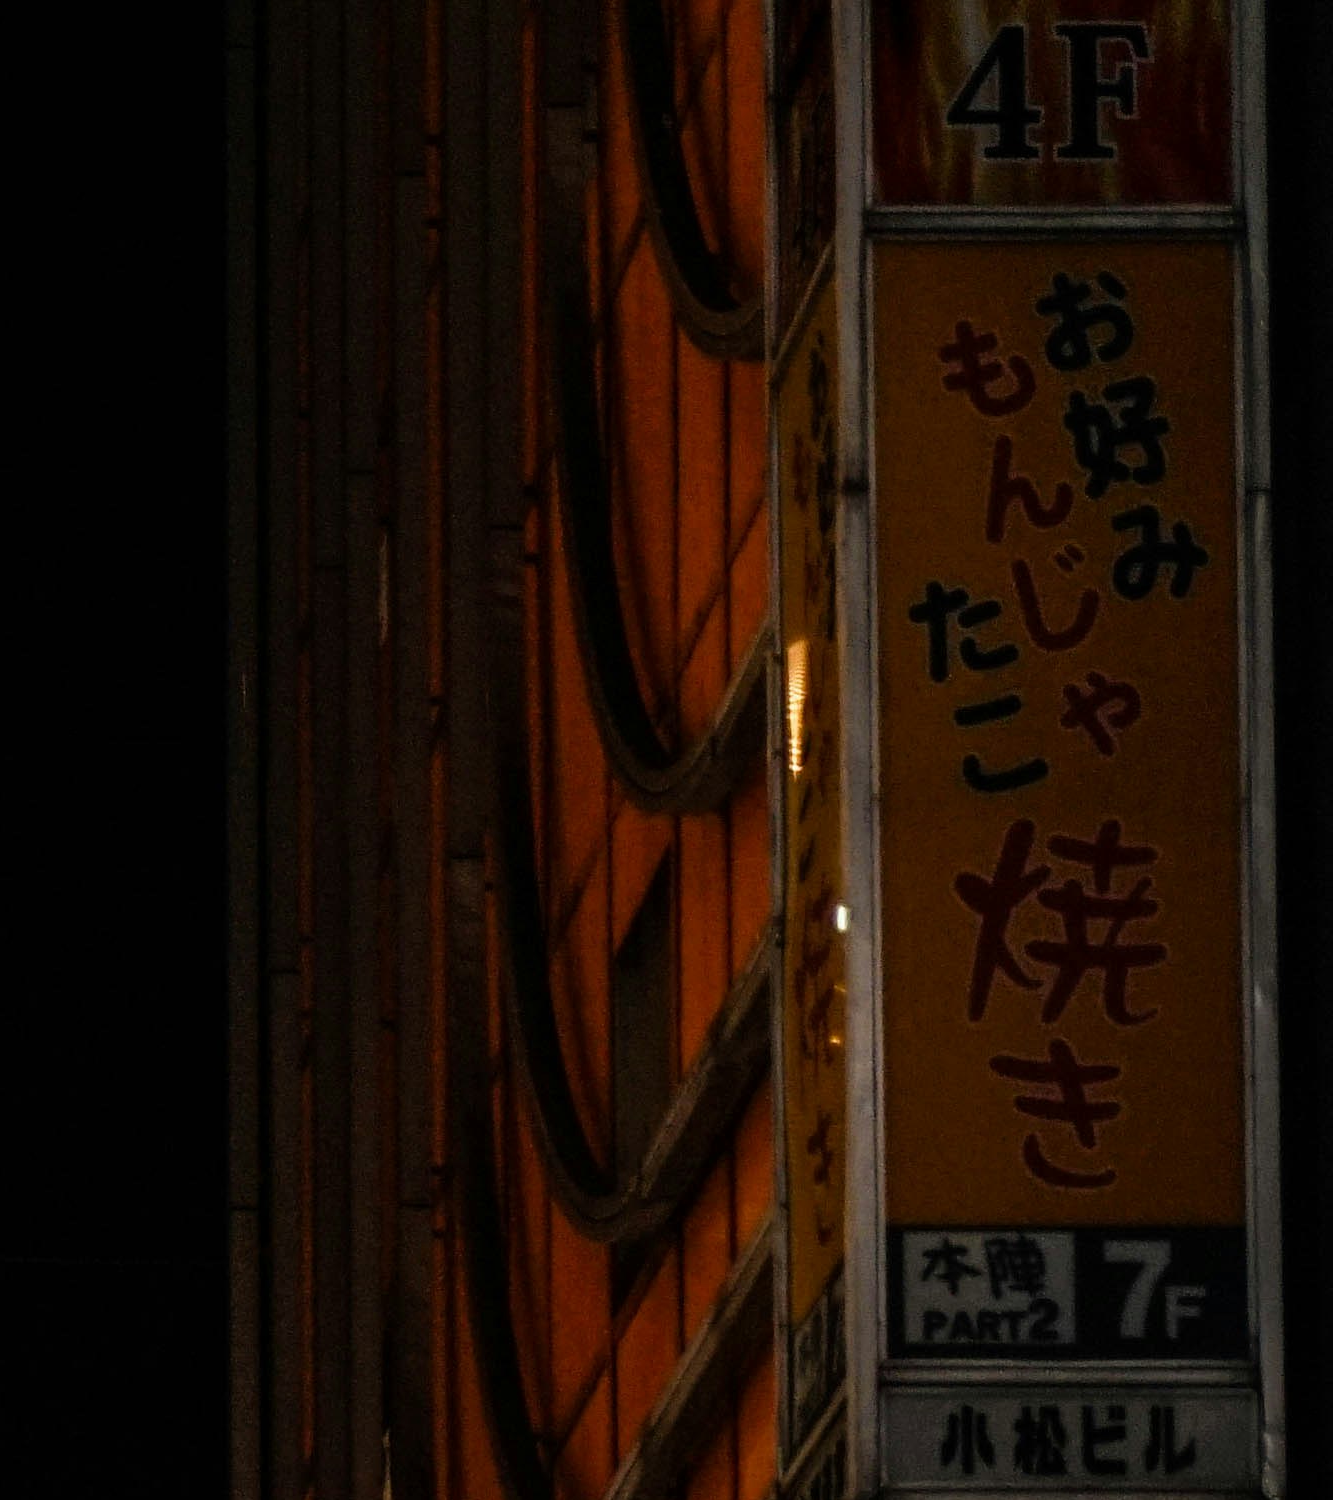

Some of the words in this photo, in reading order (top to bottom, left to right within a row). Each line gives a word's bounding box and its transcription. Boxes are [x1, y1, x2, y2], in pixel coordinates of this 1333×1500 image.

[946, 22, 1152, 160] 4F
[920, 1236, 1047, 1302] 本陣
[1103, 1240, 1207, 1340] 7F
[922, 1297, 1061, 1343] PART2
[940, 1404, 1197, 1480] 小松ビル
